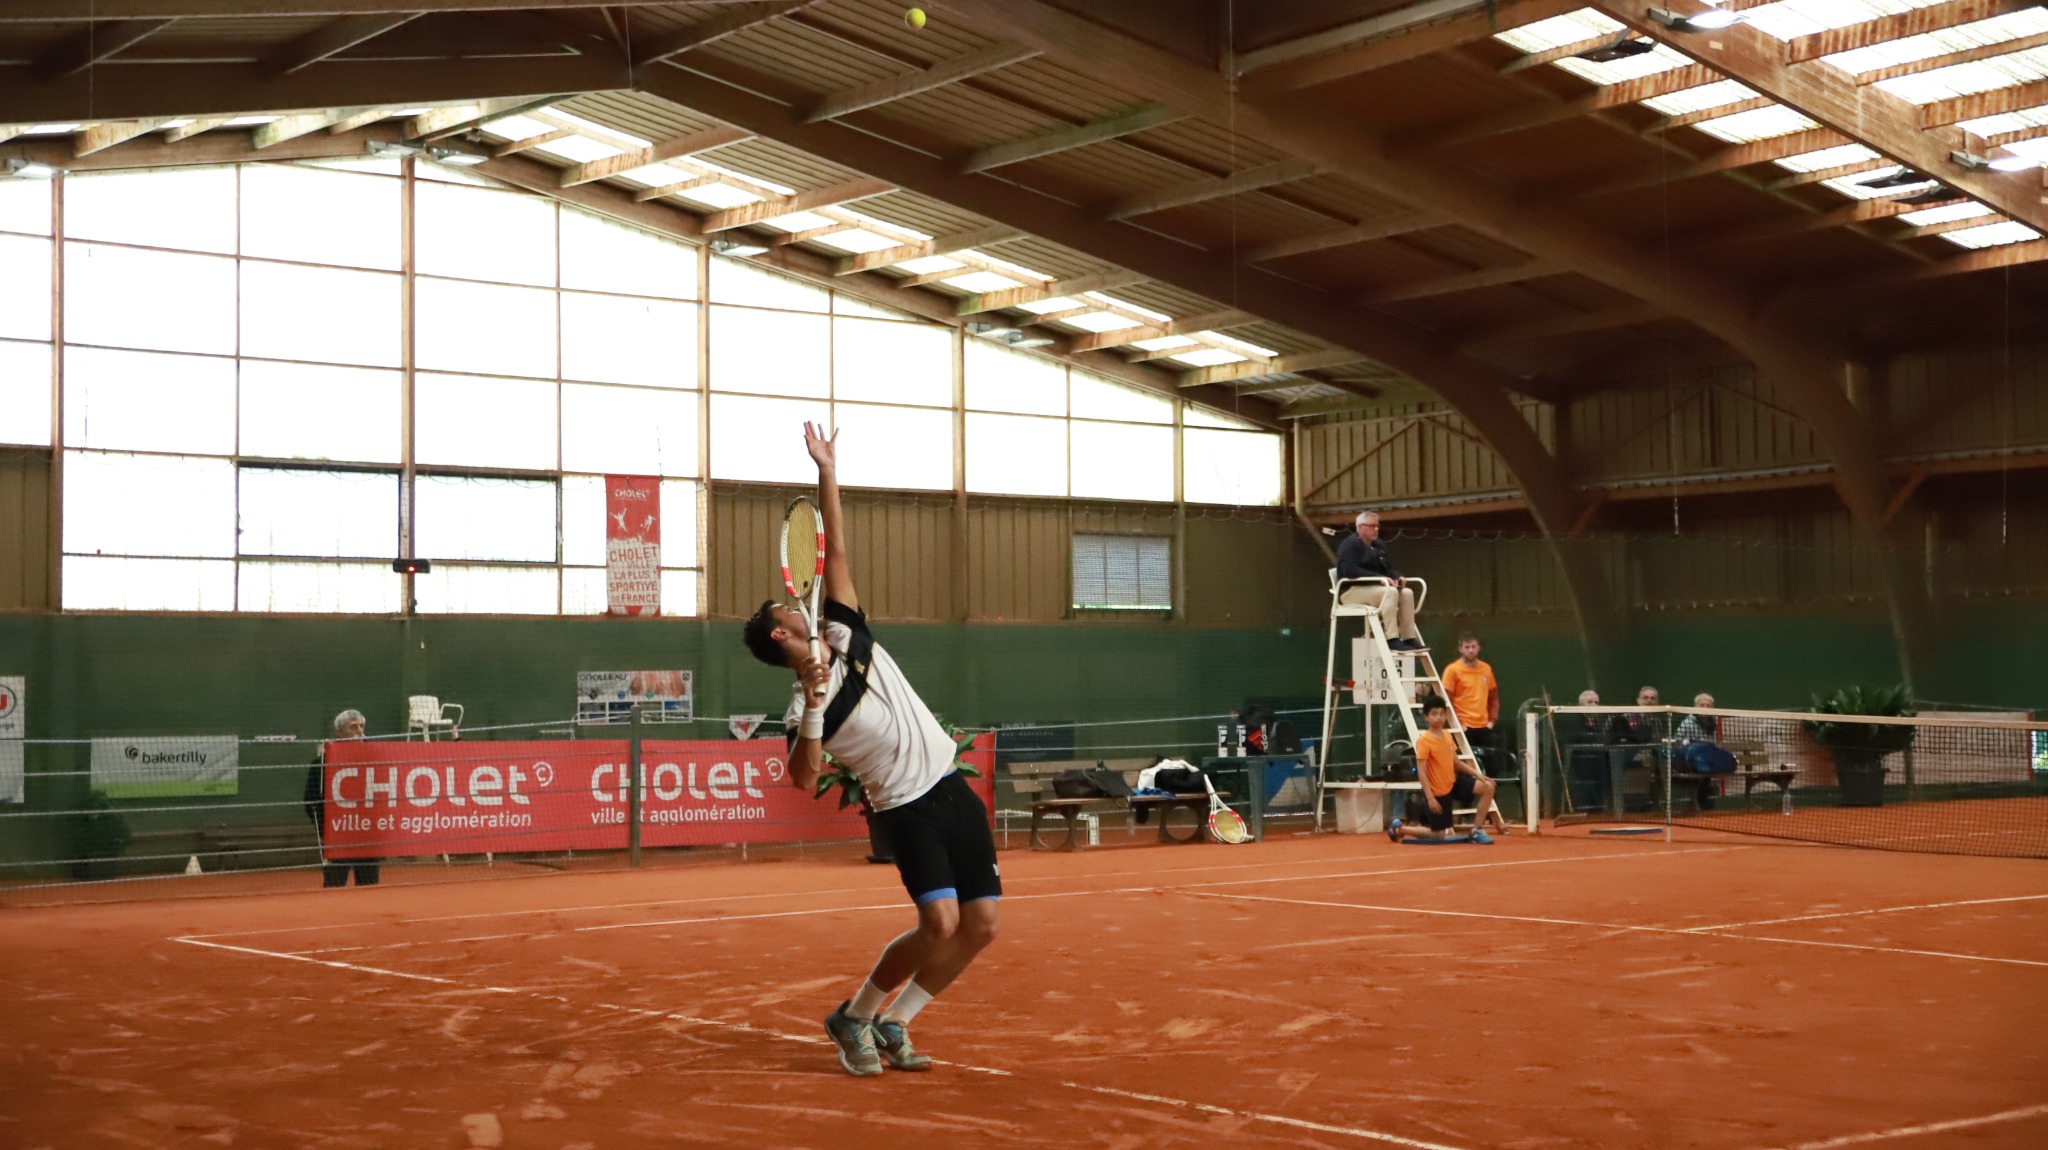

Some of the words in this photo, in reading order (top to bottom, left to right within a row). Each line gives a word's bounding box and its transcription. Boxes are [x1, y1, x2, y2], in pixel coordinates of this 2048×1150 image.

[610, 547, 657, 562] CHOLET
[614, 571, 626, 580] LA
[628, 571, 651, 580] PLUS
[609, 582, 657, 591] SPORTIVE
[622, 594, 657, 603] FRANCE
[142, 751, 207, 766] bakertilly
[331, 814, 371, 831] ville
[376, 813, 395, 831] et
[400, 811, 532, 834] agglomération
[591, 807, 625, 825] ville
[650, 804, 766, 826] agglomération
